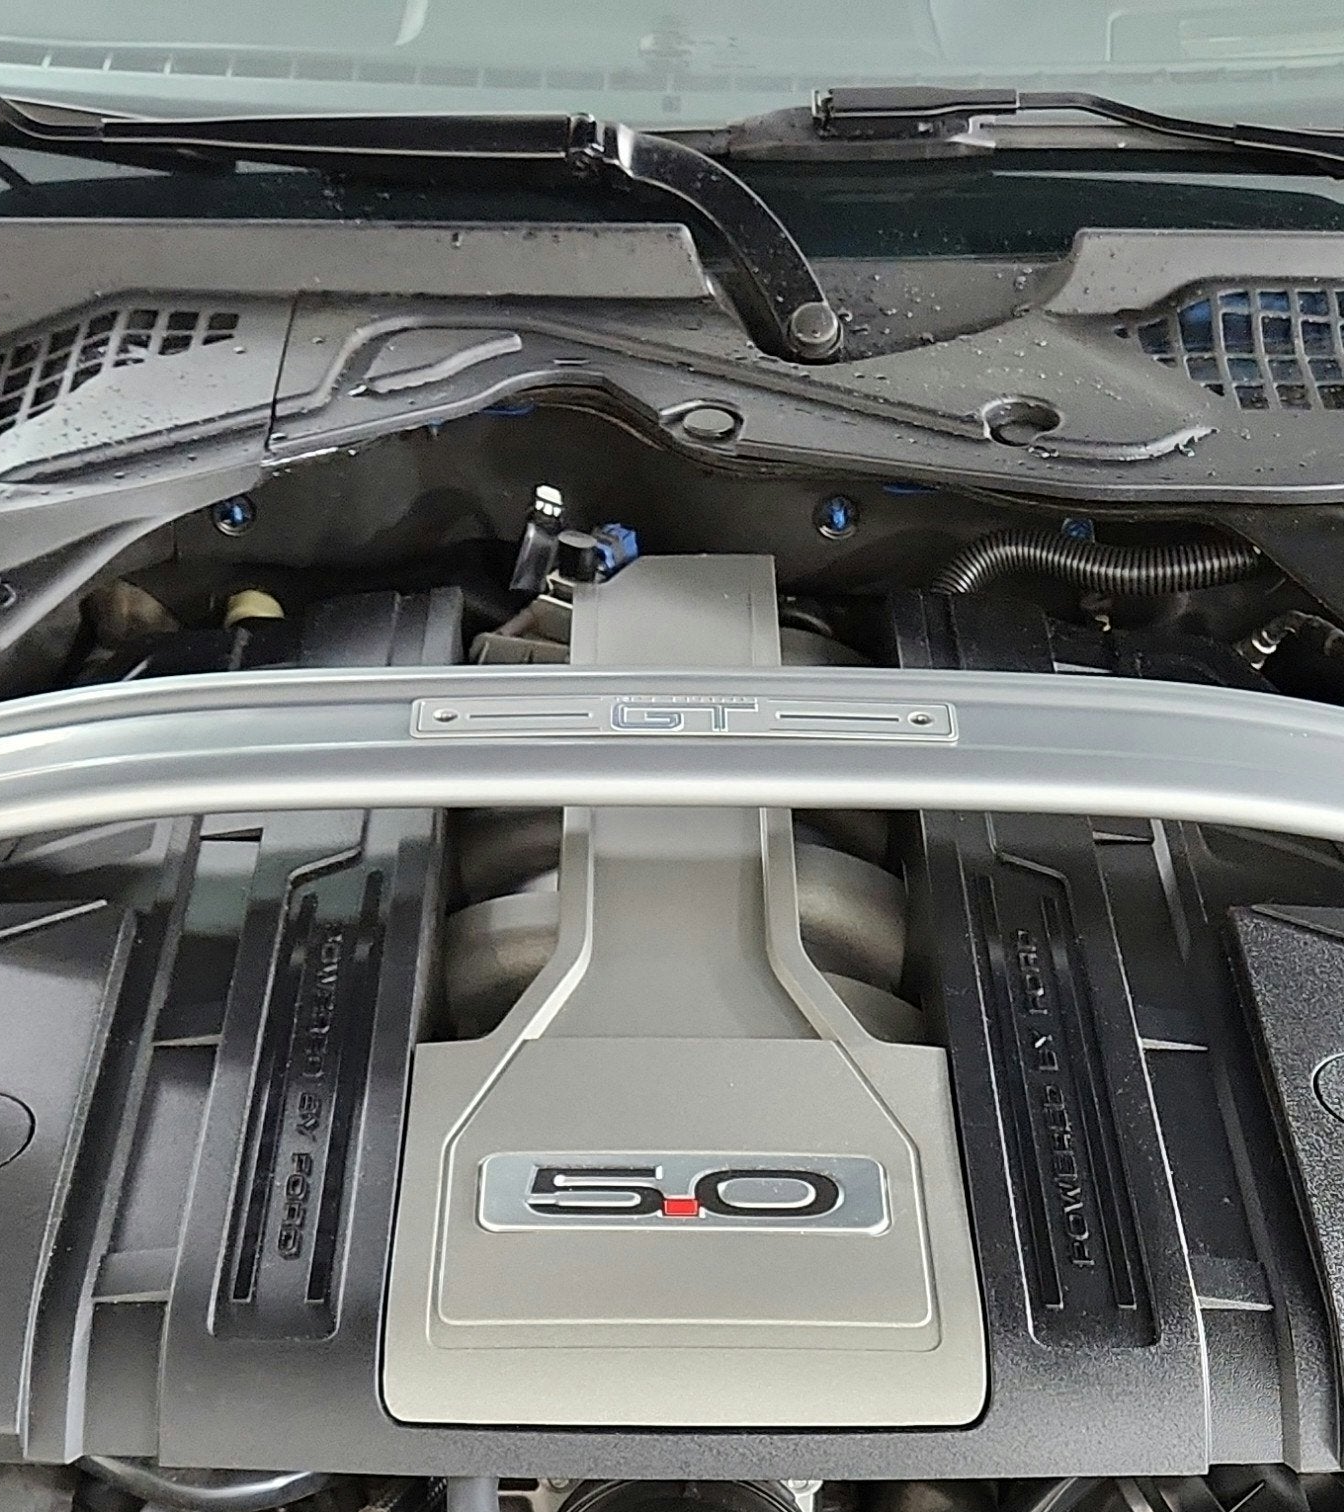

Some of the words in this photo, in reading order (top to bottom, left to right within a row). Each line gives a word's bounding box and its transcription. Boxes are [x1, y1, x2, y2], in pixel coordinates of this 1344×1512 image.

[610, 701, 759, 731] GT
[1017, 929, 1049, 1014] FORD
[1034, 1031, 1059, 1070] BY
[298, 1091, 320, 1139] BY
[524, 1164, 846, 1218] 5.0
[1043, 1084, 1095, 1269] POWERED
[276, 1151, 314, 1260] FORD
